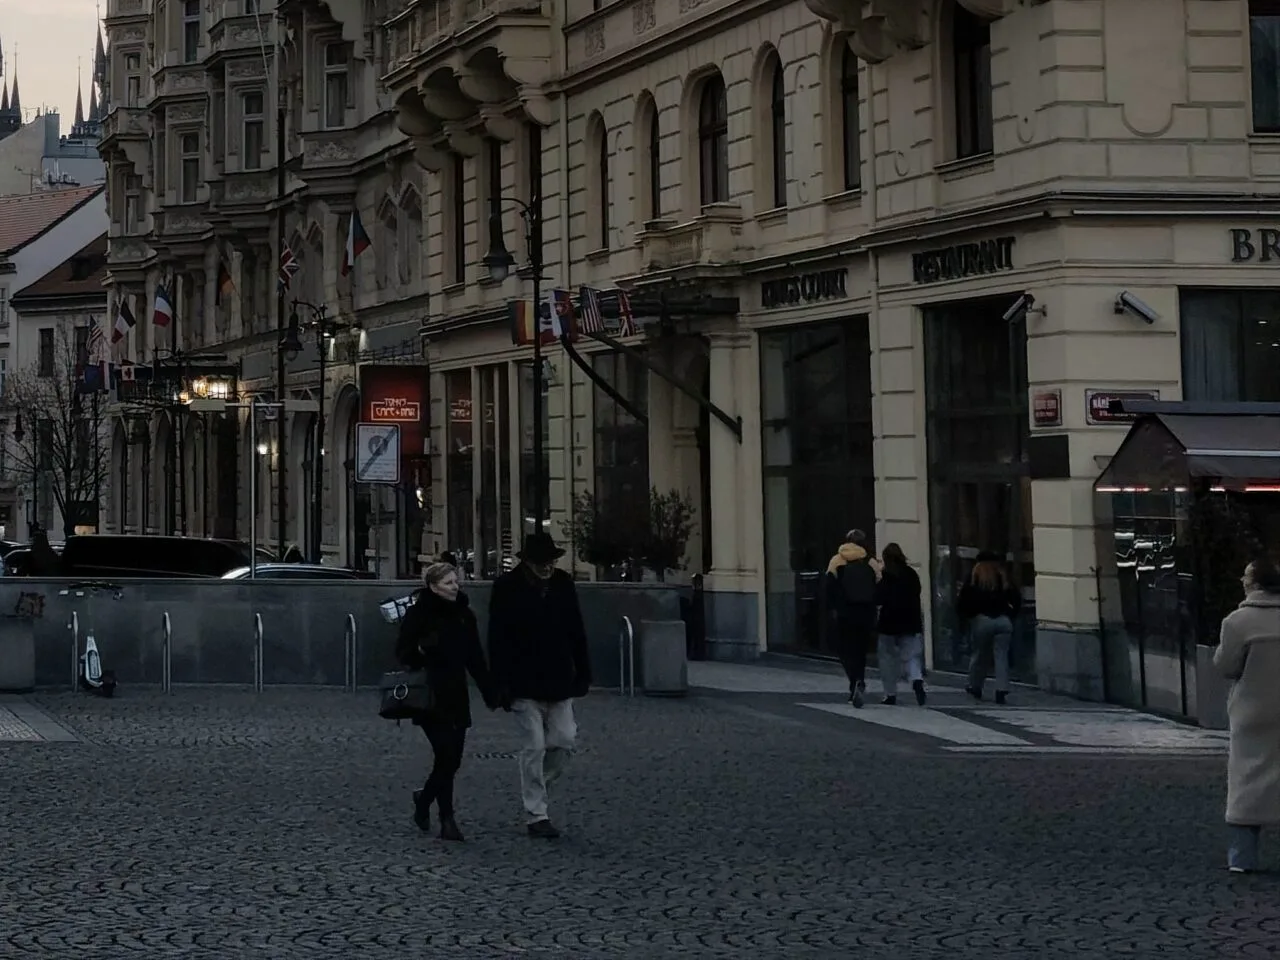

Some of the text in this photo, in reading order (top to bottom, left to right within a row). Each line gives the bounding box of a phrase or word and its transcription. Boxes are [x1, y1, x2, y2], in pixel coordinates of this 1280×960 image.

[911, 236, 1015, 284] RESTAURANT
[761, 267, 849, 308] KINGS COURT
